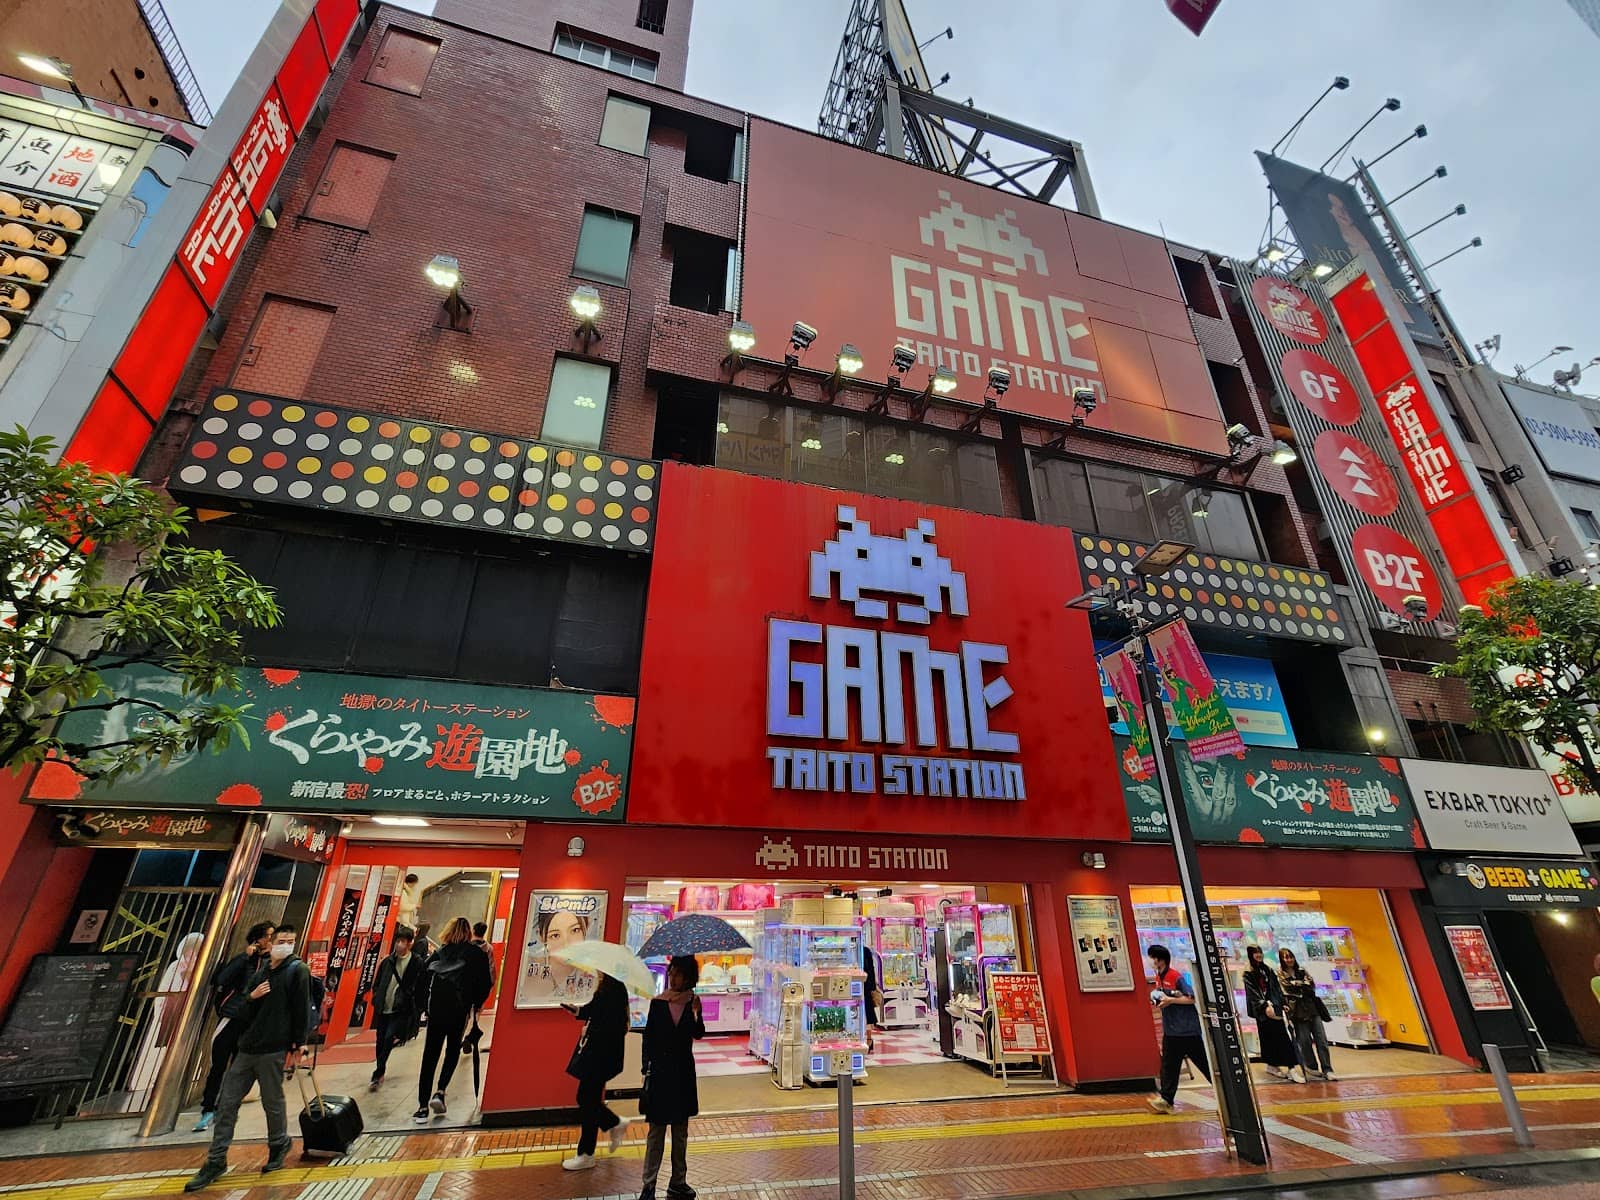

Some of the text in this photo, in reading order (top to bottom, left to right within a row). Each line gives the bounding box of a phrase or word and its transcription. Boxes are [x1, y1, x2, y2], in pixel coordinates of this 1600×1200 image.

[48, 146, 96, 188] 地酒
[184, 114, 265, 261] TAITO STATION
[191, 128, 275, 285] GAME
[890, 254, 1100, 373] GAME
[1266, 300, 1319, 331] GAME
[896, 336, 982, 378] TAITO
[1300, 368, 1341, 403] 6F
[1390, 409, 1438, 505] TAITO STATION
[1398, 401, 1454, 501] GAME
[1363, 550, 1425, 592] B2F
[340, 693, 531, 720] 地獄のタイトーステーション
[767, 618, 1021, 753] GAME
[269, 708, 568, 781] くらやみ遊園地
[290, 780, 370, 800] 新宿最恐!
[578, 780, 618, 805] B2F
[766, 747, 1027, 801] TAITO STATION
[1251, 770, 1397, 818] くらやみ遊園地
[1424, 790, 1489, 813] EXBAR
[1484, 820, 1500, 830] Beer
[804, 844, 949, 870] TAITO STATION
